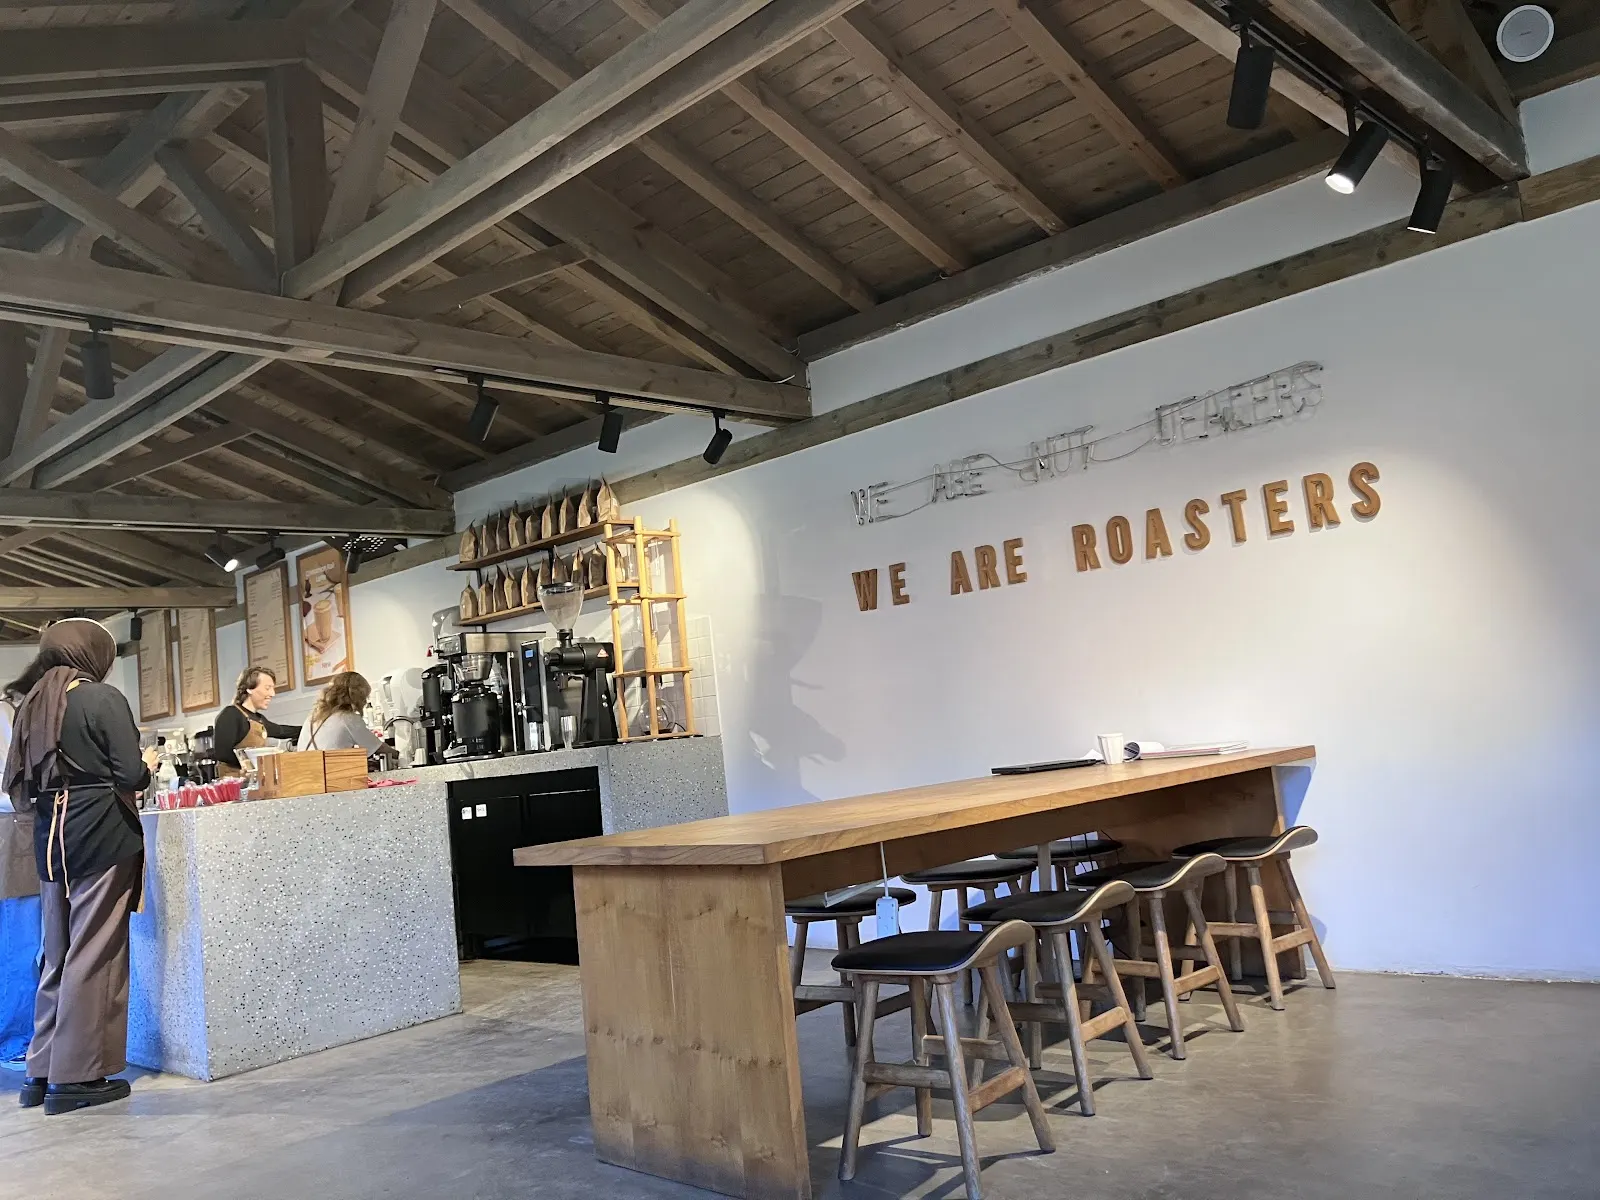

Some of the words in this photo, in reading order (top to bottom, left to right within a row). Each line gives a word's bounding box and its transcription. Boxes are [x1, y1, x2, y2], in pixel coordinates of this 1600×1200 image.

[850, 481, 889, 526] WE
[931, 453, 988, 504] ARE
[852, 562, 910, 612] WE
[950, 537, 1028, 595] ARE
[1071, 461, 1382, 573] ROASTERS
